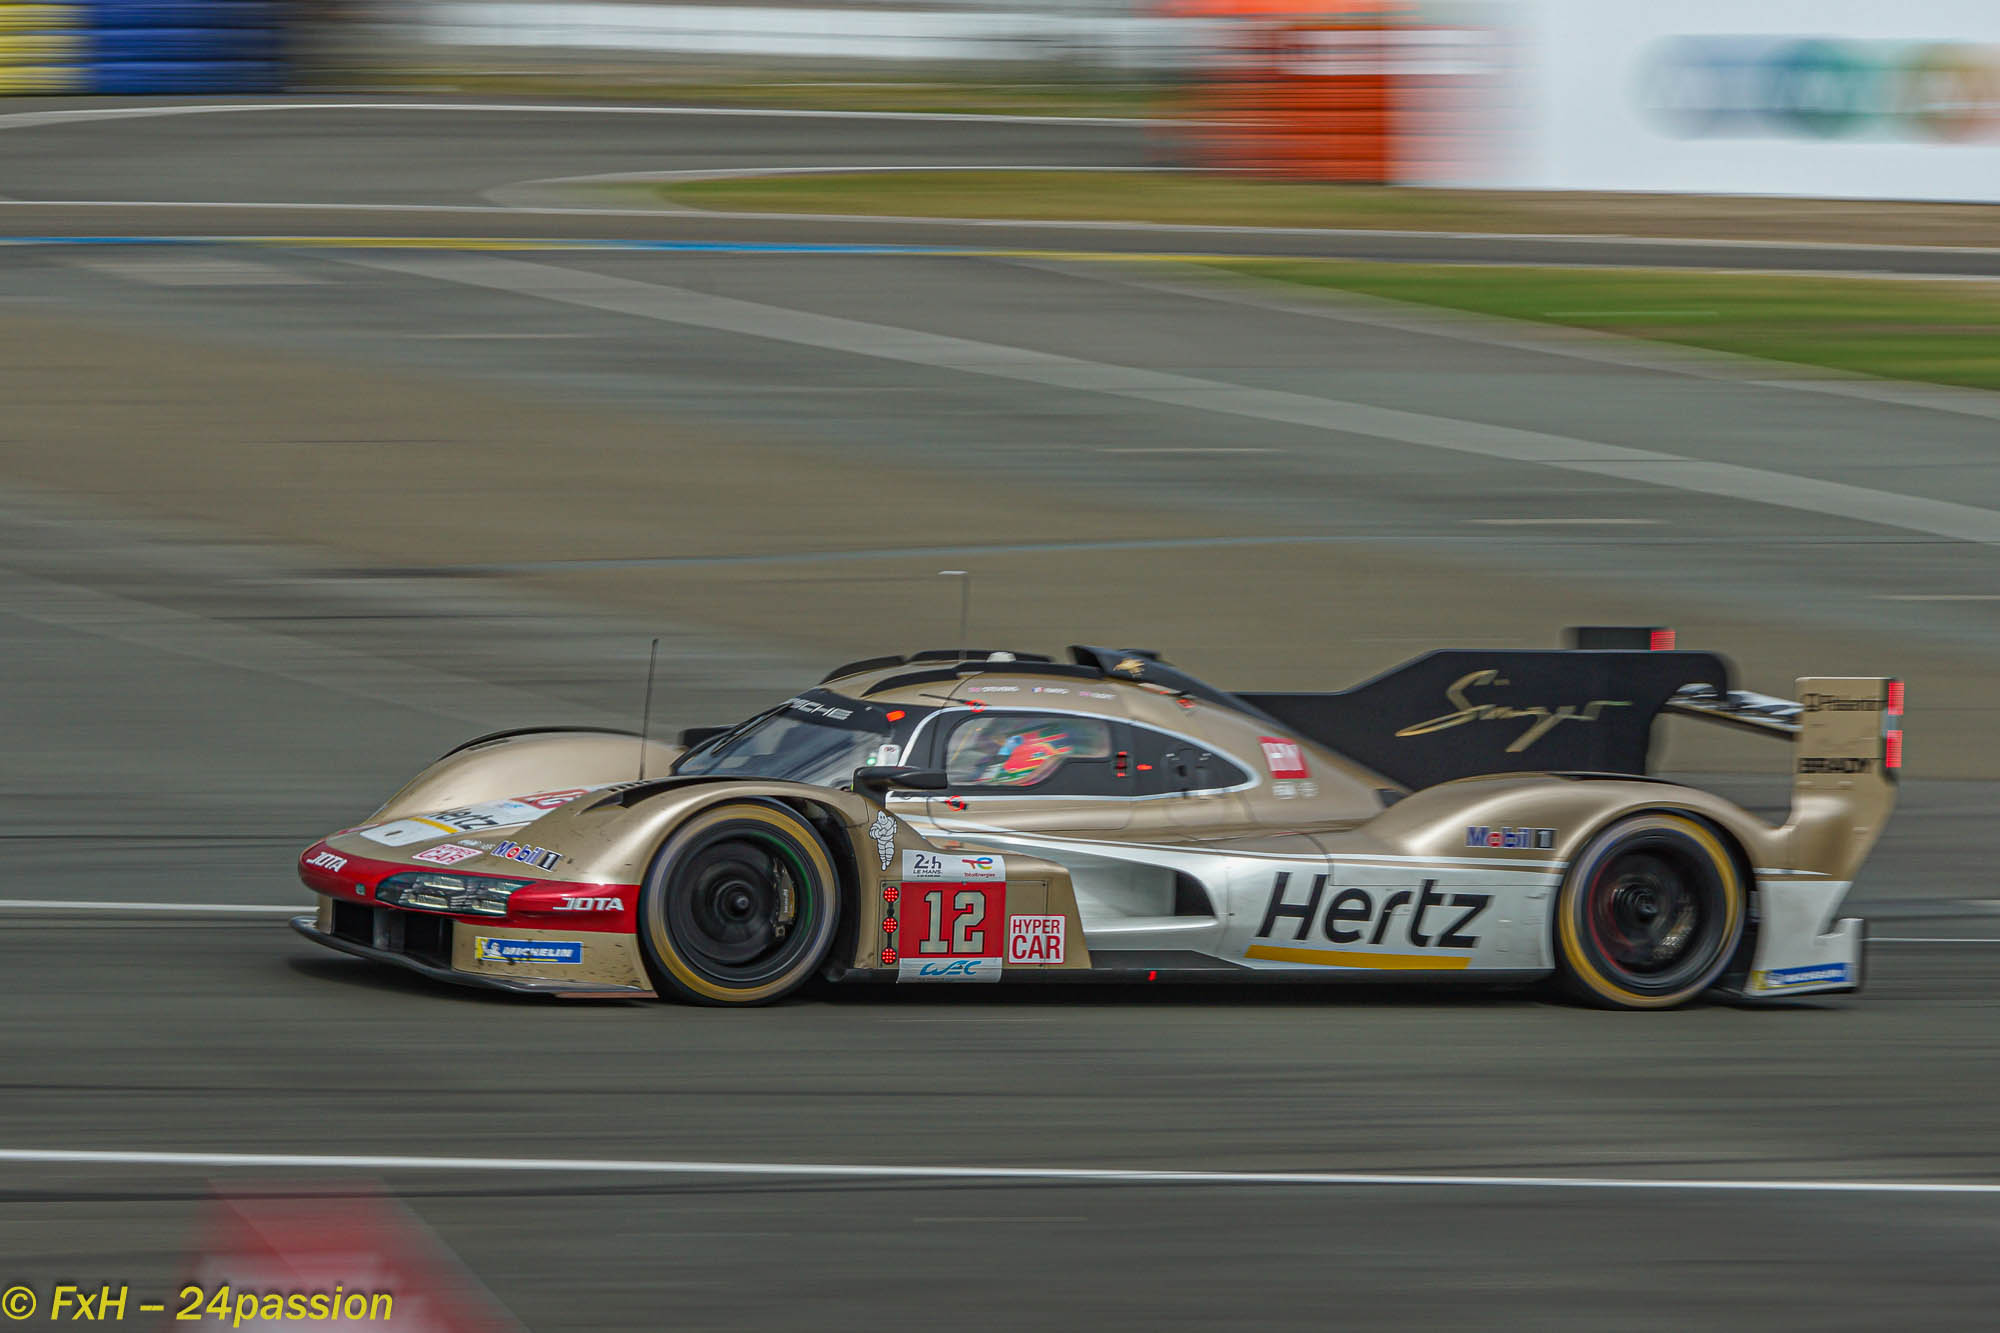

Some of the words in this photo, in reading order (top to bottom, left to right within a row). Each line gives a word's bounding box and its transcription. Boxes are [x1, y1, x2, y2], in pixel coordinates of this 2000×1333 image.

[1465, 826, 1529, 848] Mobil
[306, 851, 347, 872] JOTA
[490, 840, 544, 865] Mobil
[552, 897, 624, 911] JOTA
[1256, 871, 1495, 949] Hertz
[919, 890, 986, 954] 12
[1013, 919, 1060, 934] HYPER
[502, 946, 574, 957] MICHELIN
[1012, 935, 1060, 959] CAR
